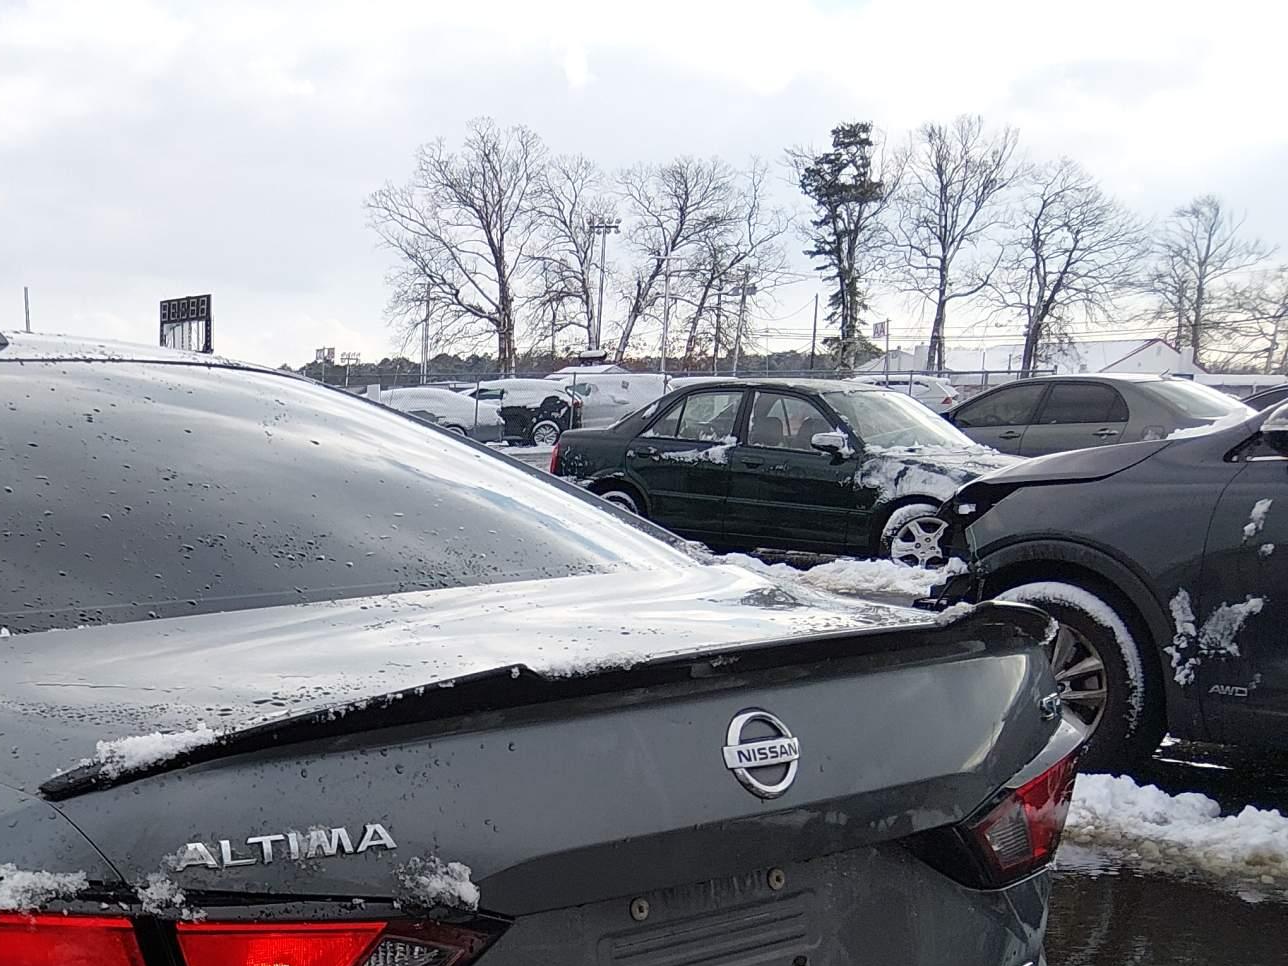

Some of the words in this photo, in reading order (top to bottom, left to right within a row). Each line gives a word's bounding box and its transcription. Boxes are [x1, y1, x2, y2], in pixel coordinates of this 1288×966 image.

[1208, 684, 1248, 697] AWD
[736, 741, 799, 764] NISSAN
[175, 823, 398, 872] ALTIMA
